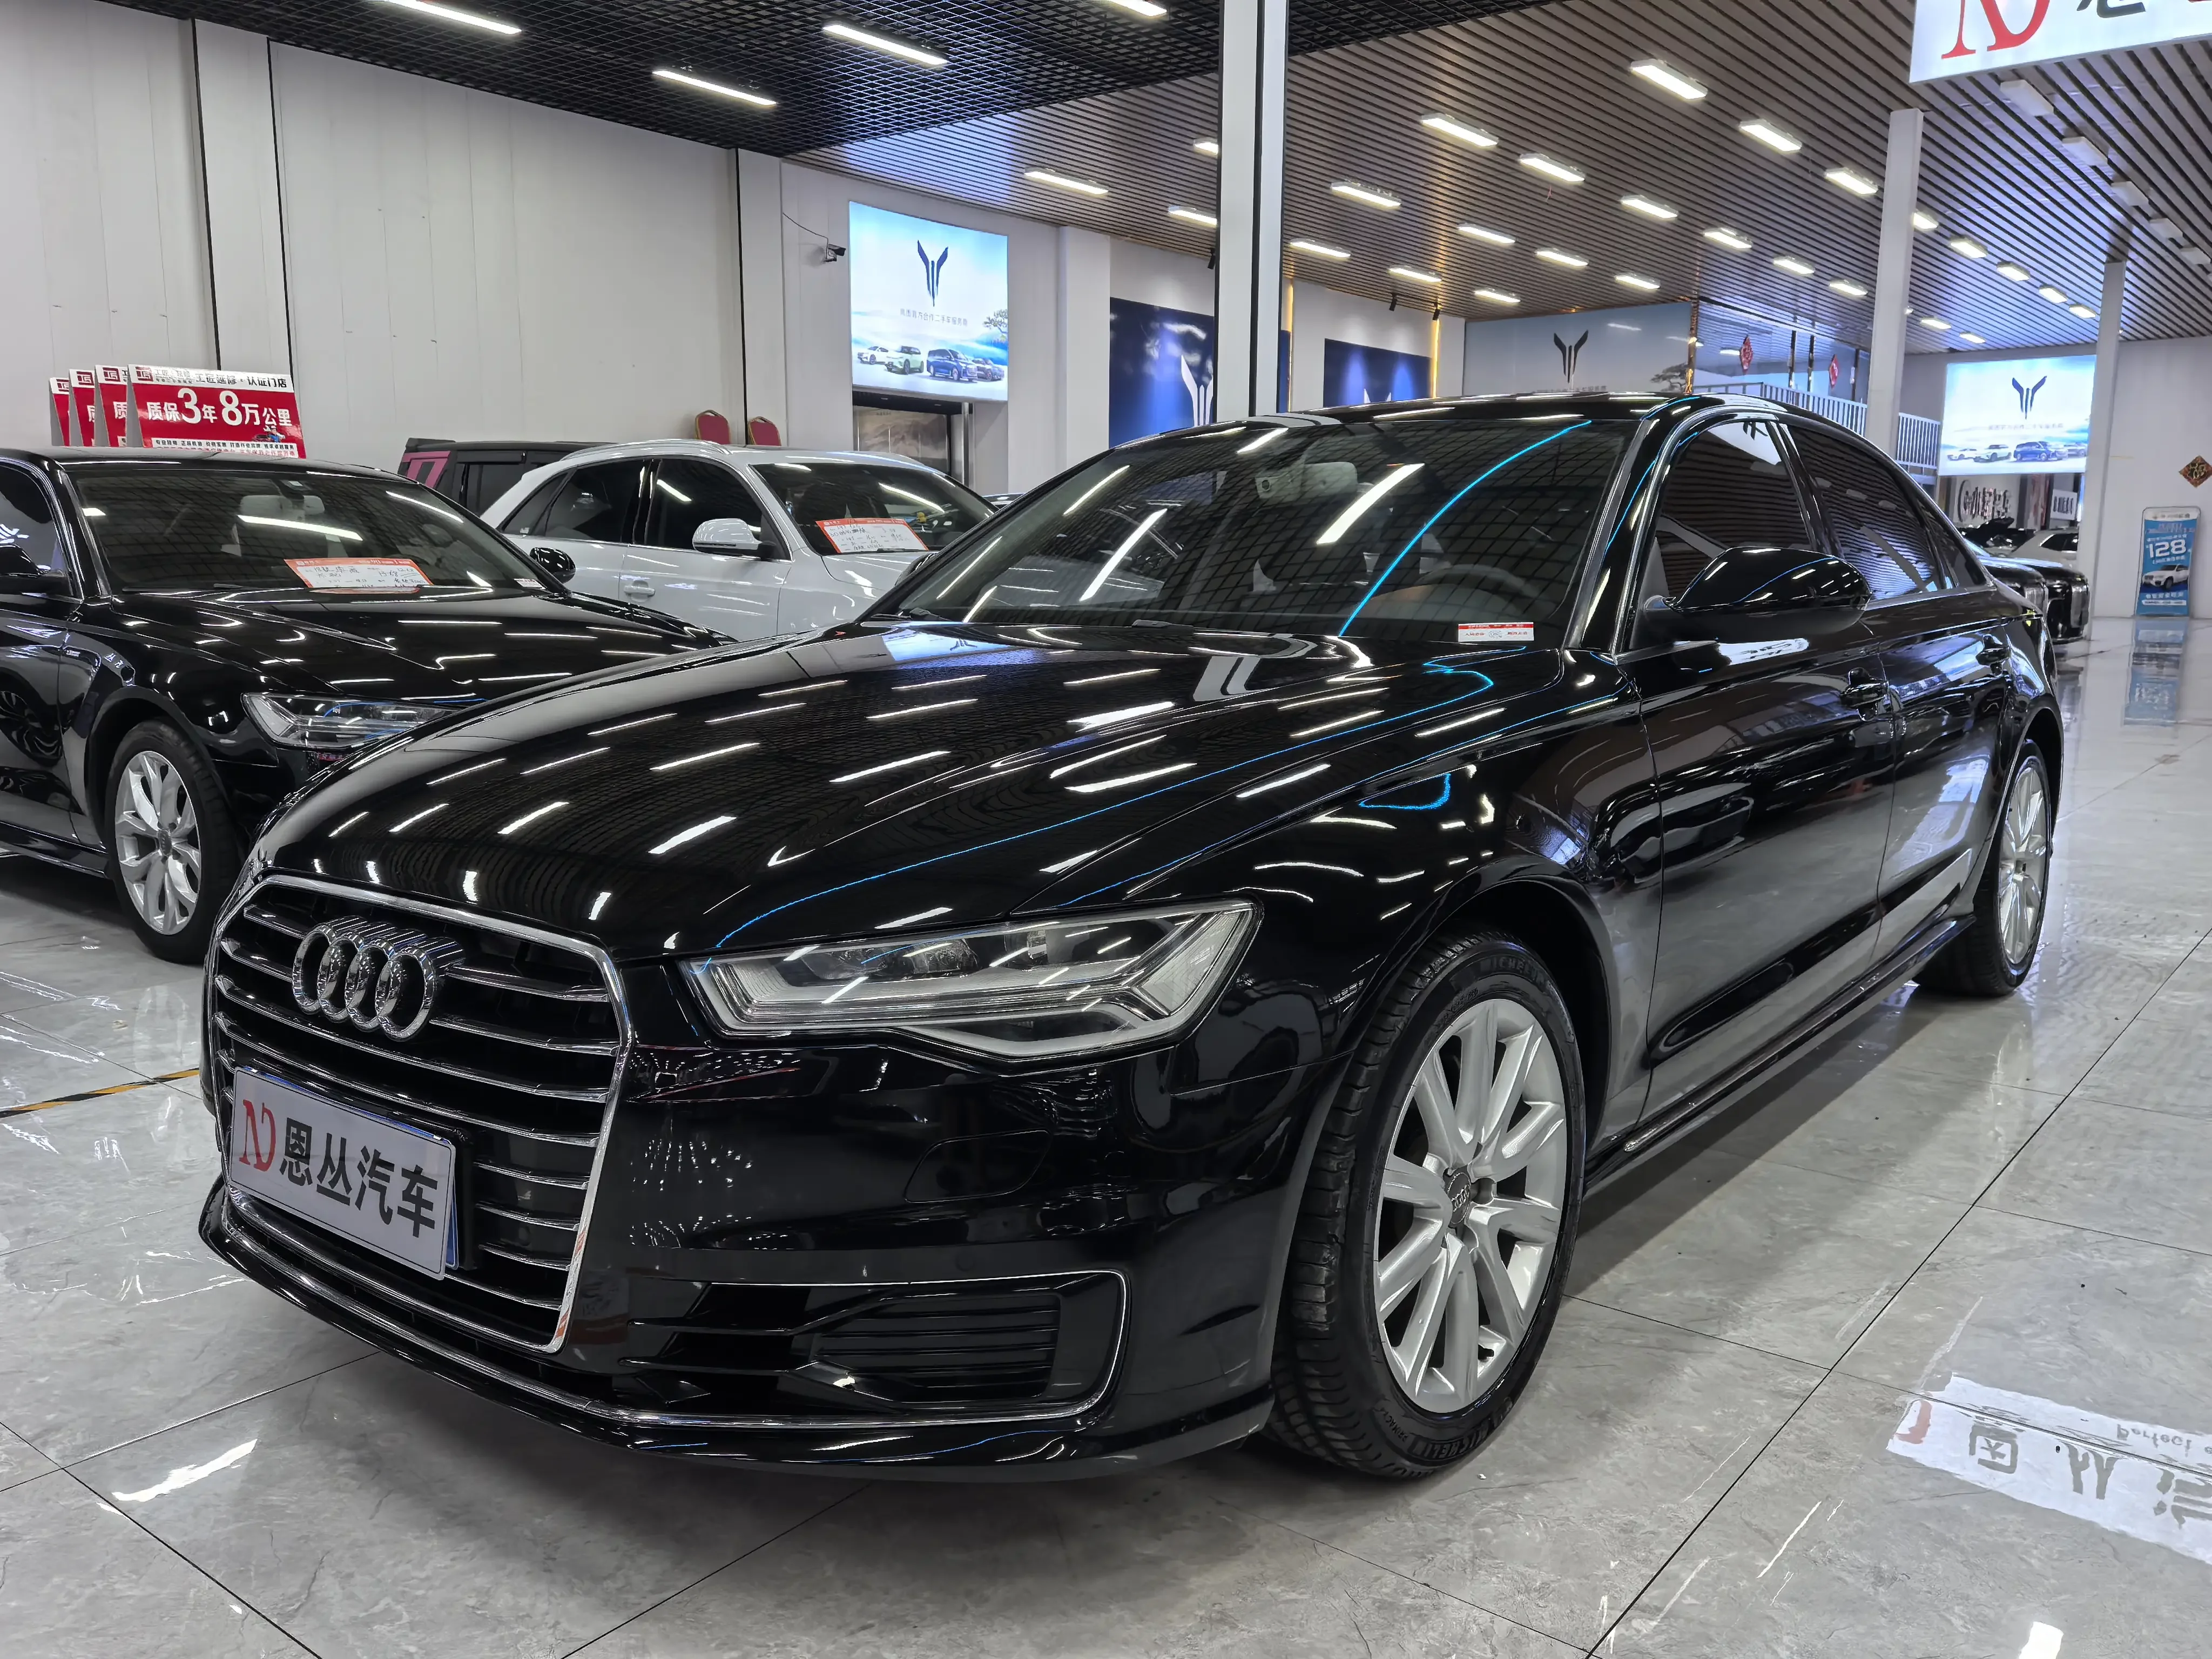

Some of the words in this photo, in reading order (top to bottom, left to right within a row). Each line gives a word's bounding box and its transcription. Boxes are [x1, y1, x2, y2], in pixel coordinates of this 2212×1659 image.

[2149, 539, 2187, 558] 128
[280, 1117, 438, 1238] 恩丛汽车
